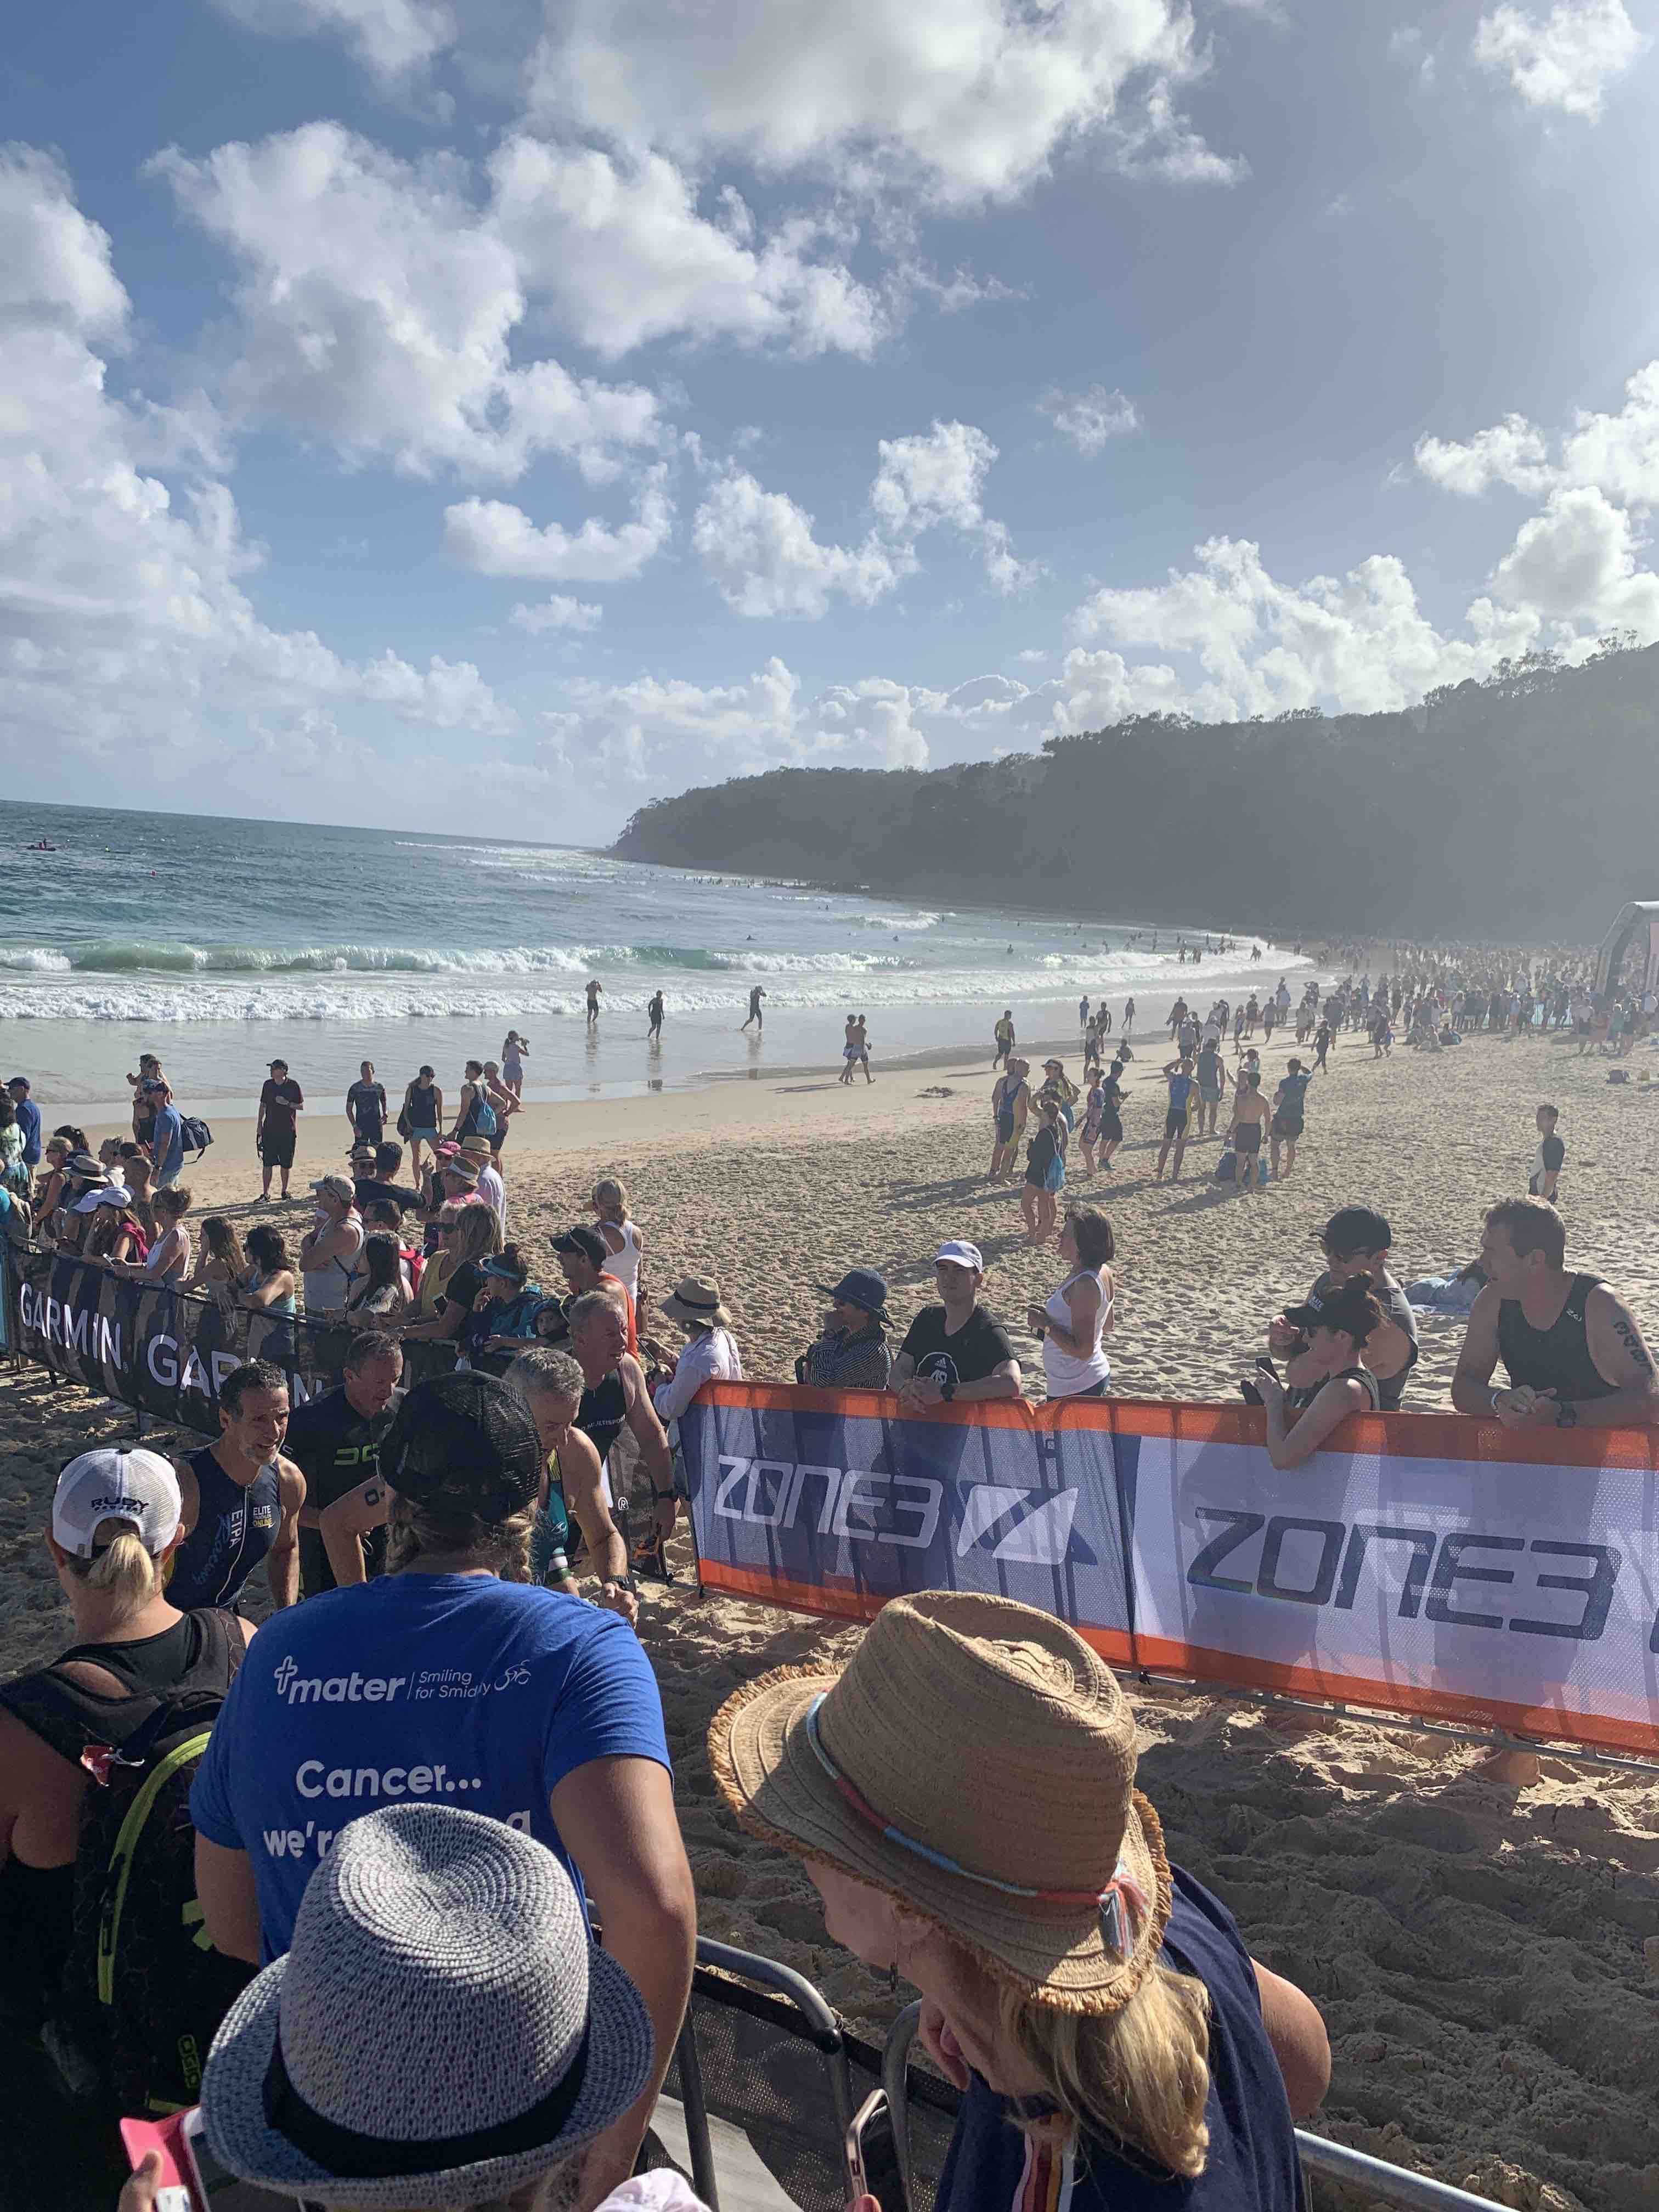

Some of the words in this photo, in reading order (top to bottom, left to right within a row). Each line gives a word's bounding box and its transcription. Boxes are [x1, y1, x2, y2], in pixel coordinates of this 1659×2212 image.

[20, 1283, 121, 1370] GARMIN
[147, 1334, 324, 1408] GARN
[91, 1497, 150, 1516] RUDY
[253, 1505, 272, 1516] ELITE
[714, 1454, 944, 1549] ZONE3
[1187, 1506, 1622, 1641] ZONE3
[288, 1672, 405, 1704] mater
[415, 1686, 435, 1700] for
[439, 1682, 491, 1698] Smidy
[419, 1669, 472, 1685] Smiling
[296, 1759, 482, 1798] Cancer...
[263, 1821, 343, 1859] we'r
